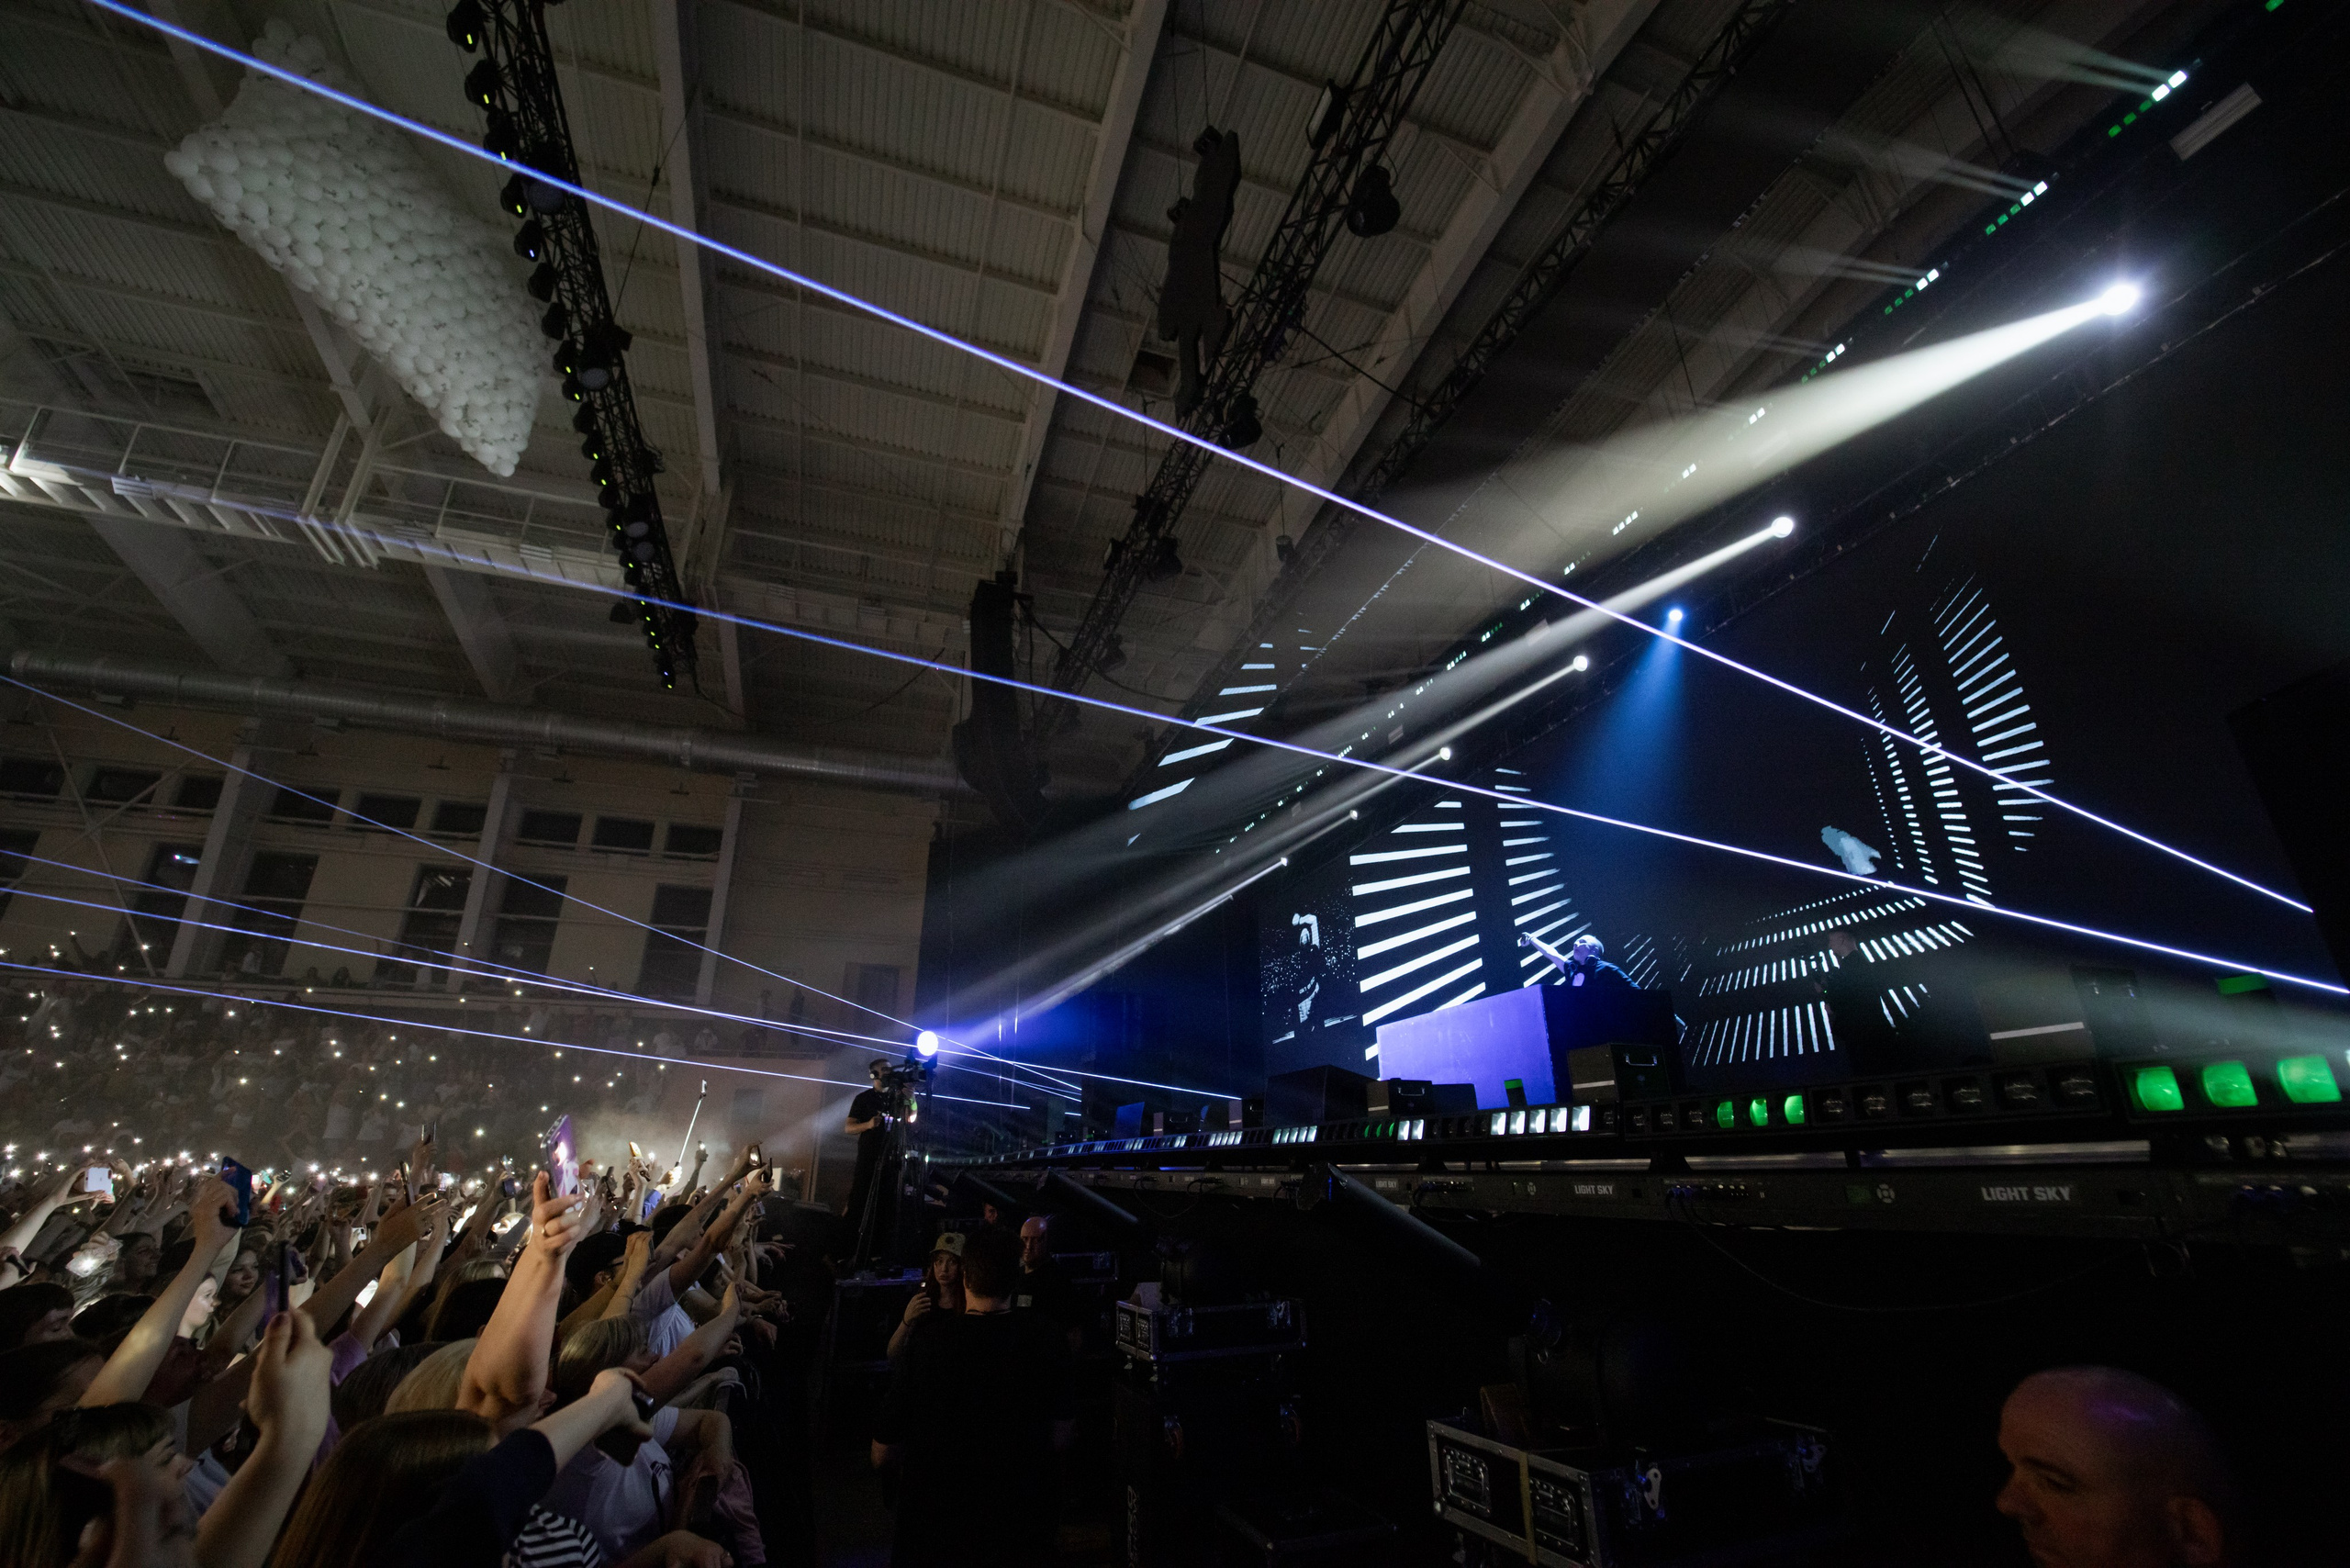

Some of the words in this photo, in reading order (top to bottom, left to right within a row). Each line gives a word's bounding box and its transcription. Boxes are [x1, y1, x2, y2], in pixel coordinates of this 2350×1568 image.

[1574, 1184, 1595, 1194] LIGHT
[1597, 1184, 1613, 1194] SKY
[1981, 1187, 2029, 1201] LIGHT
[2033, 1186, 2071, 1201] SKY
